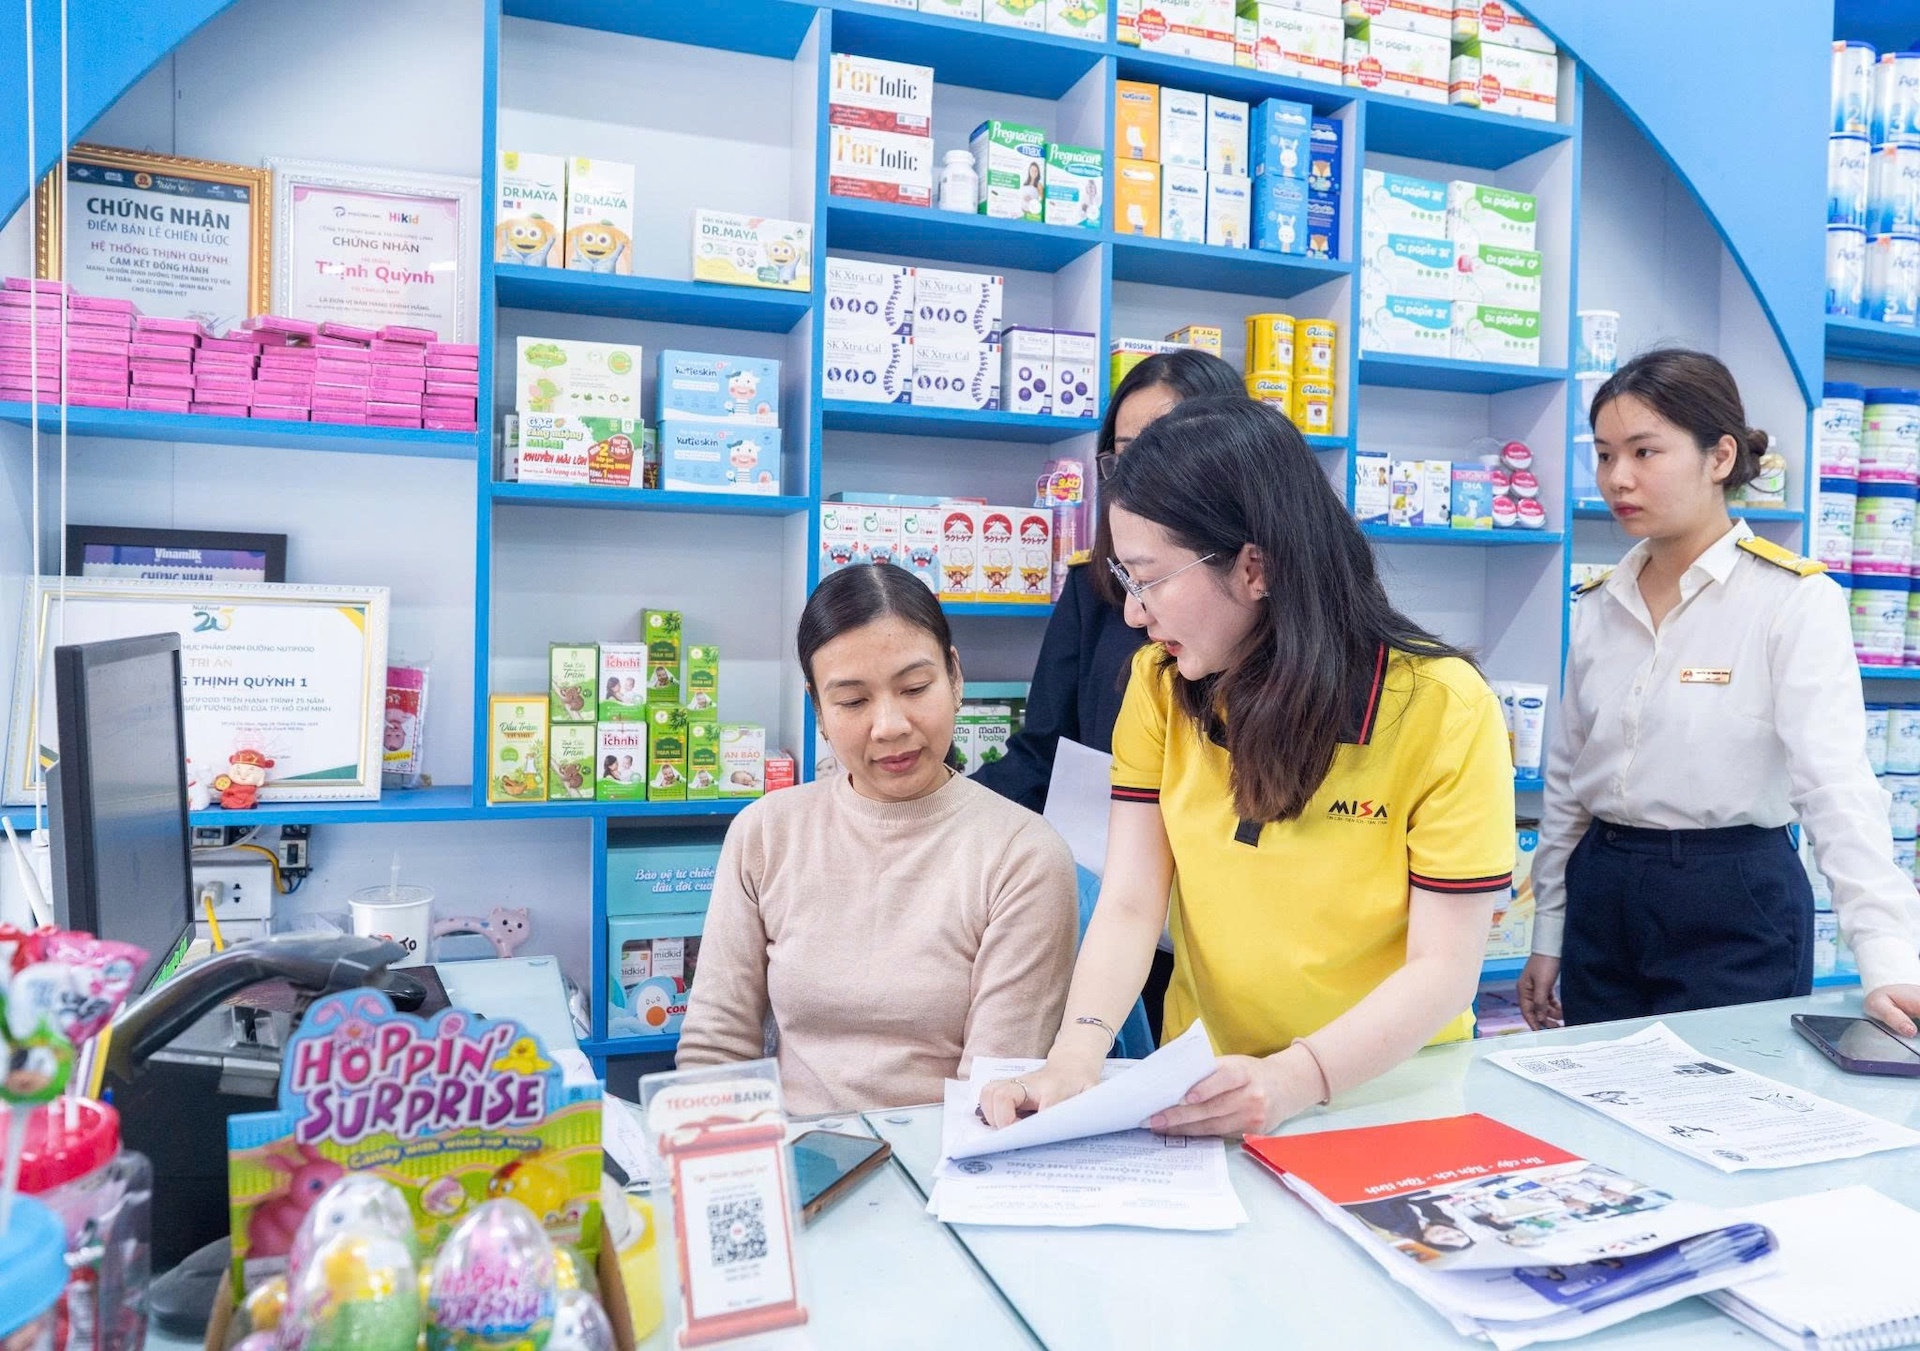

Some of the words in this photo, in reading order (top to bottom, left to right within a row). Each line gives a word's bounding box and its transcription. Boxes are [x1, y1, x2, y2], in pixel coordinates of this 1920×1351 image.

[993, 121, 1044, 144] Pregnacare
[1022, 146, 1042, 157] max
[1050, 144, 1101, 166] Pregnacare
[503, 186, 558, 202] DR.MAYA
[1402, 186, 1430, 199] papie
[573, 192, 628, 210] DR.MAYA
[1494, 197, 1520, 209] papie
[86, 197, 164, 222] CHỨNG
[170, 207, 230, 232] NHẬN
[389, 211, 419, 225] Hikid
[702, 224, 758, 242] DR.MAYA
[332, 235, 379, 250] CHỨNG
[382, 241, 420, 254] NHẬN
[1408, 244, 1436, 256] papie
[91, 240, 106, 252] HỆ
[110, 241, 149, 256] THỐNG
[153, 248, 186, 261] THỊNH
[189, 250, 229, 265] QUỲNH
[1499, 255, 1525, 268] papie
[375, 266, 435, 285] Quỳnh
[1405, 306, 1434, 318] papie
[1497, 315, 1524, 327] papie
[1125, 342, 1153, 350] PROSPAN
[676, 436, 718, 447] kutieskin
[600, 443, 608, 457] 2
[1463, 482, 1482, 490] DHA
[154, 548, 202, 562] Vinamilk
[193, 677, 239, 689] THỊNH
[243, 675, 296, 689] QUỲNH
[300, 678, 308, 688] 1
[978, 726, 1006, 735] MaMa
[983, 734, 1005, 743] baby
[1328, 800, 1387, 818] MISA
[635, 868, 657, 881] Bảo
[660, 870, 673, 882] vệ
[676, 868, 688, 879] từ
[652, 881, 673, 893] đầu
[675, 880, 691, 891] đời
[654, 950, 682, 959] midkid
[295, 1022, 517, 1091] HOPPIN'
[665, 1089, 773, 1111] TECHCOMBANK
[297, 1073, 546, 1143] SURPRISE
